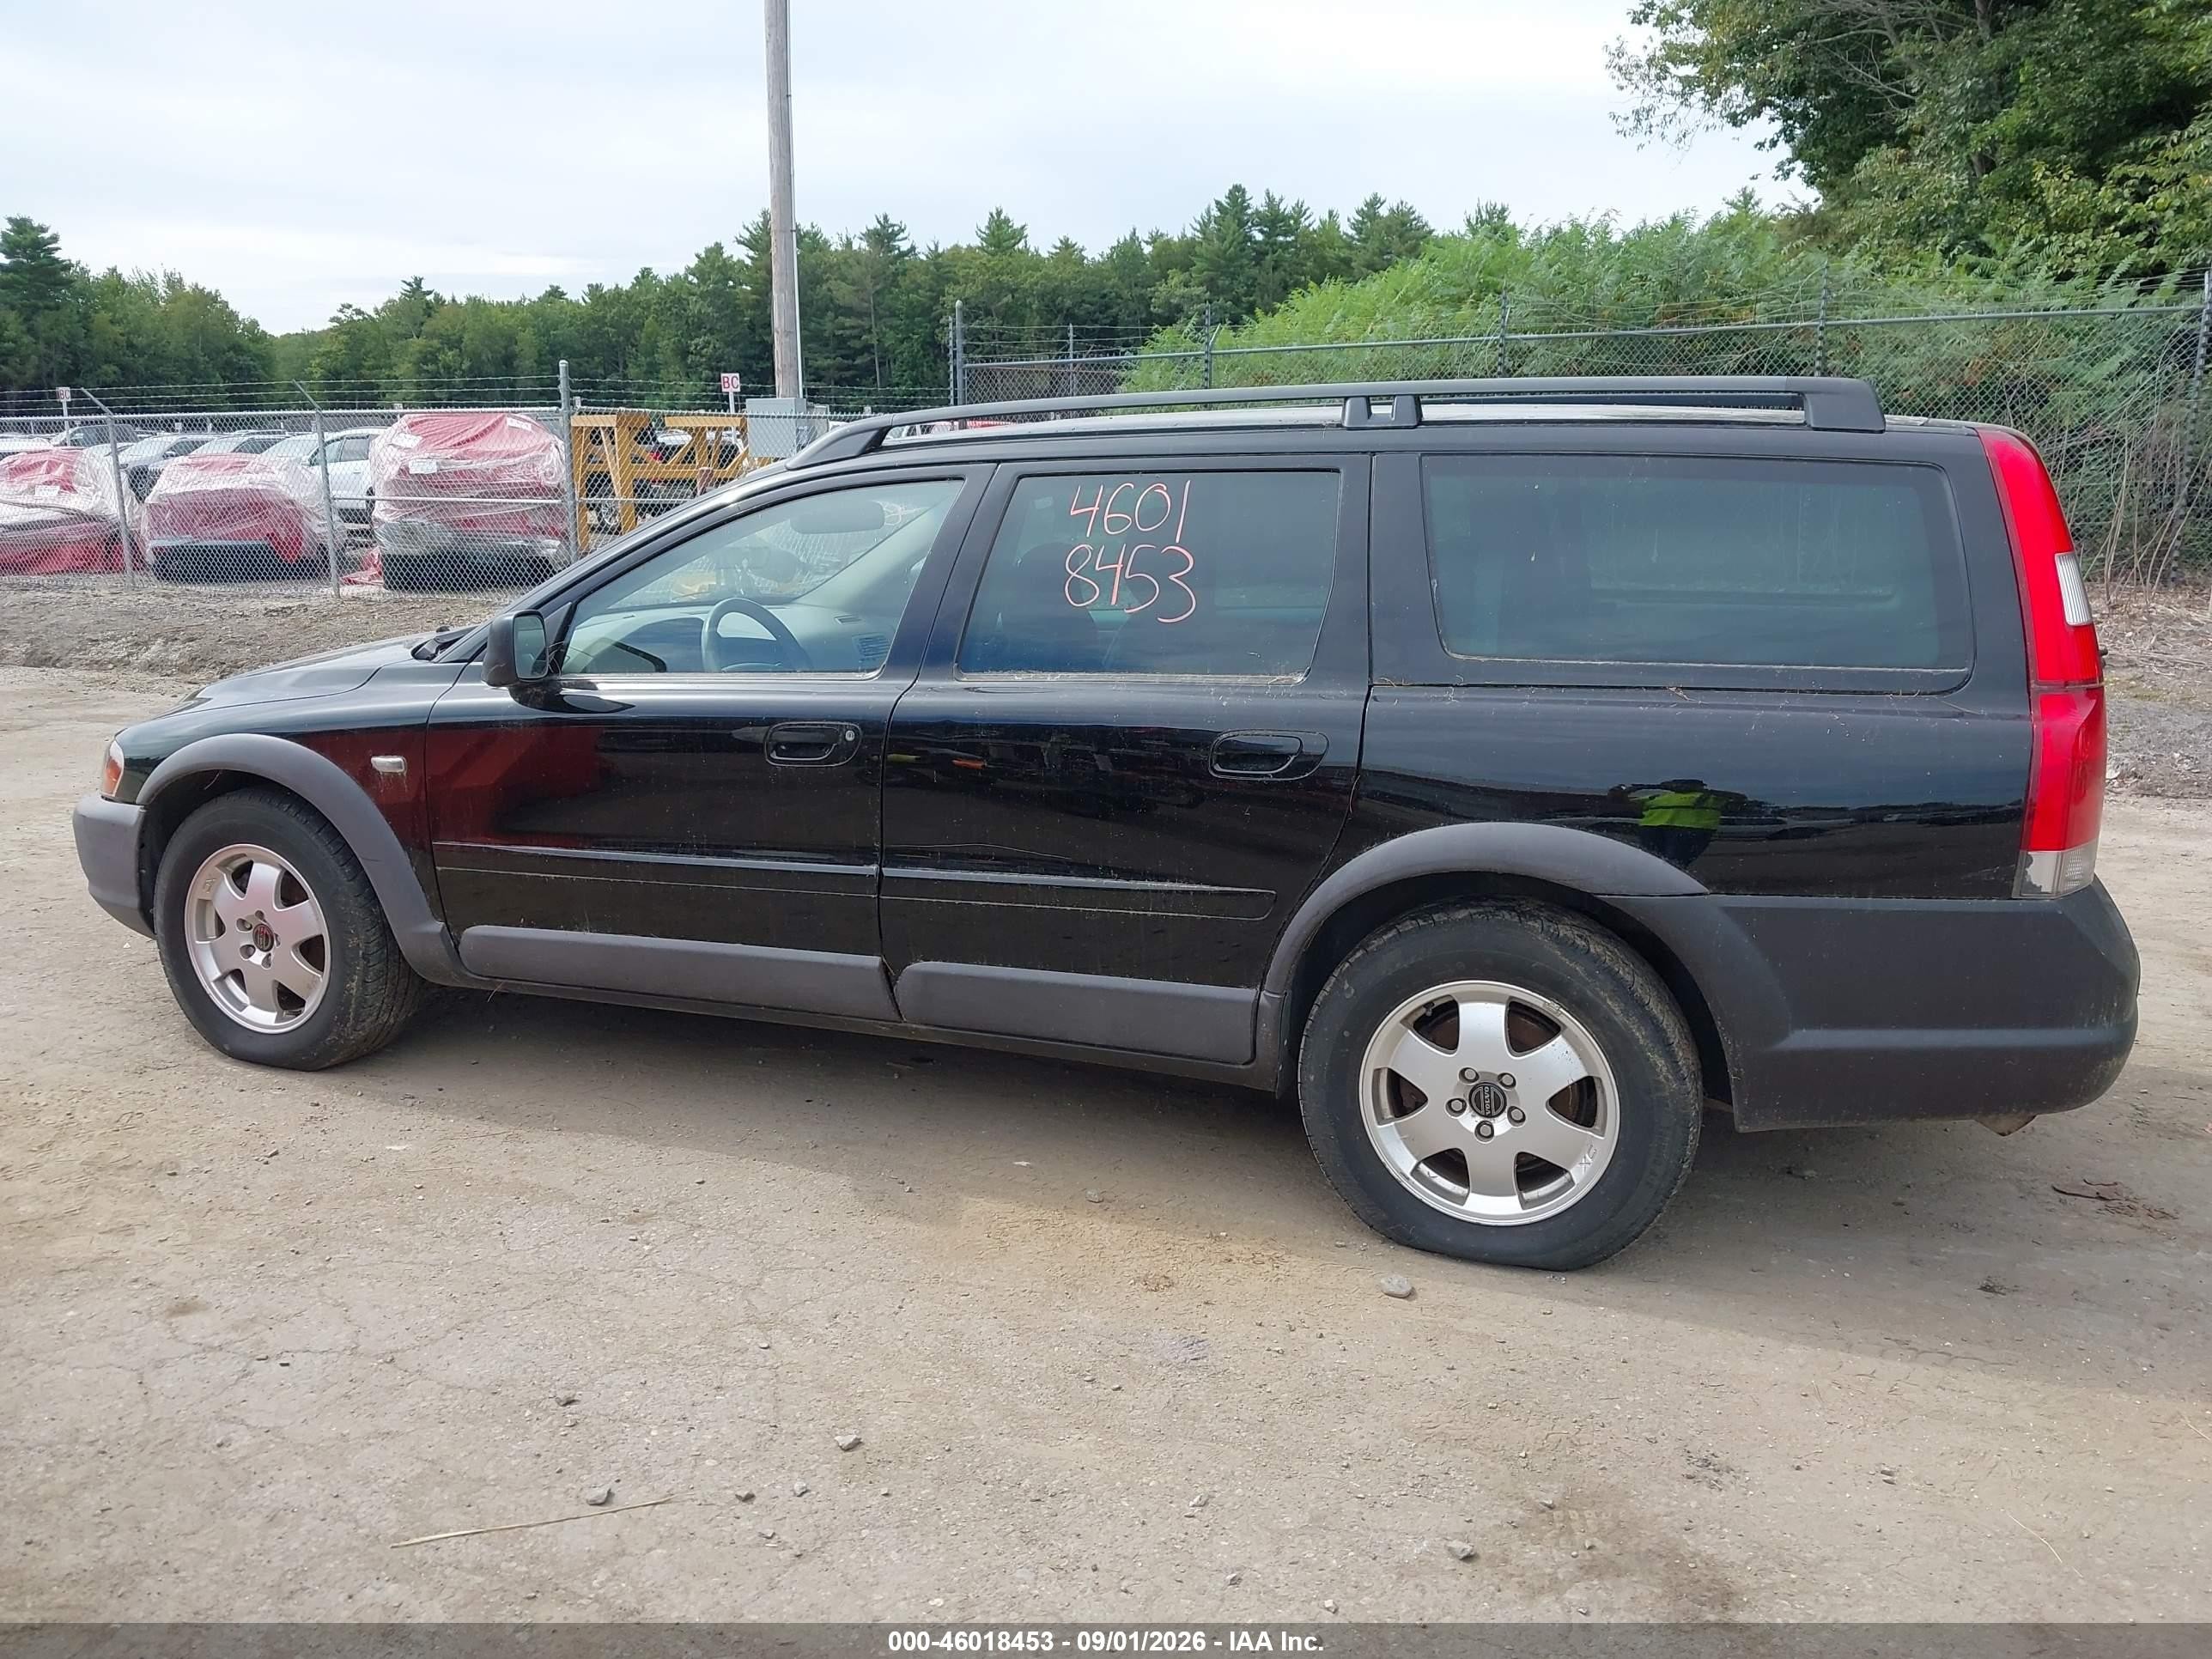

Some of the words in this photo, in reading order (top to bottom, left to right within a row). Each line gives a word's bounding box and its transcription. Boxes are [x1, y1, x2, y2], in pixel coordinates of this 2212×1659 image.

[722, 375, 739, 389] BC
[1070, 479, 1191, 544] 4601
[1065, 544, 1196, 623] 8453
